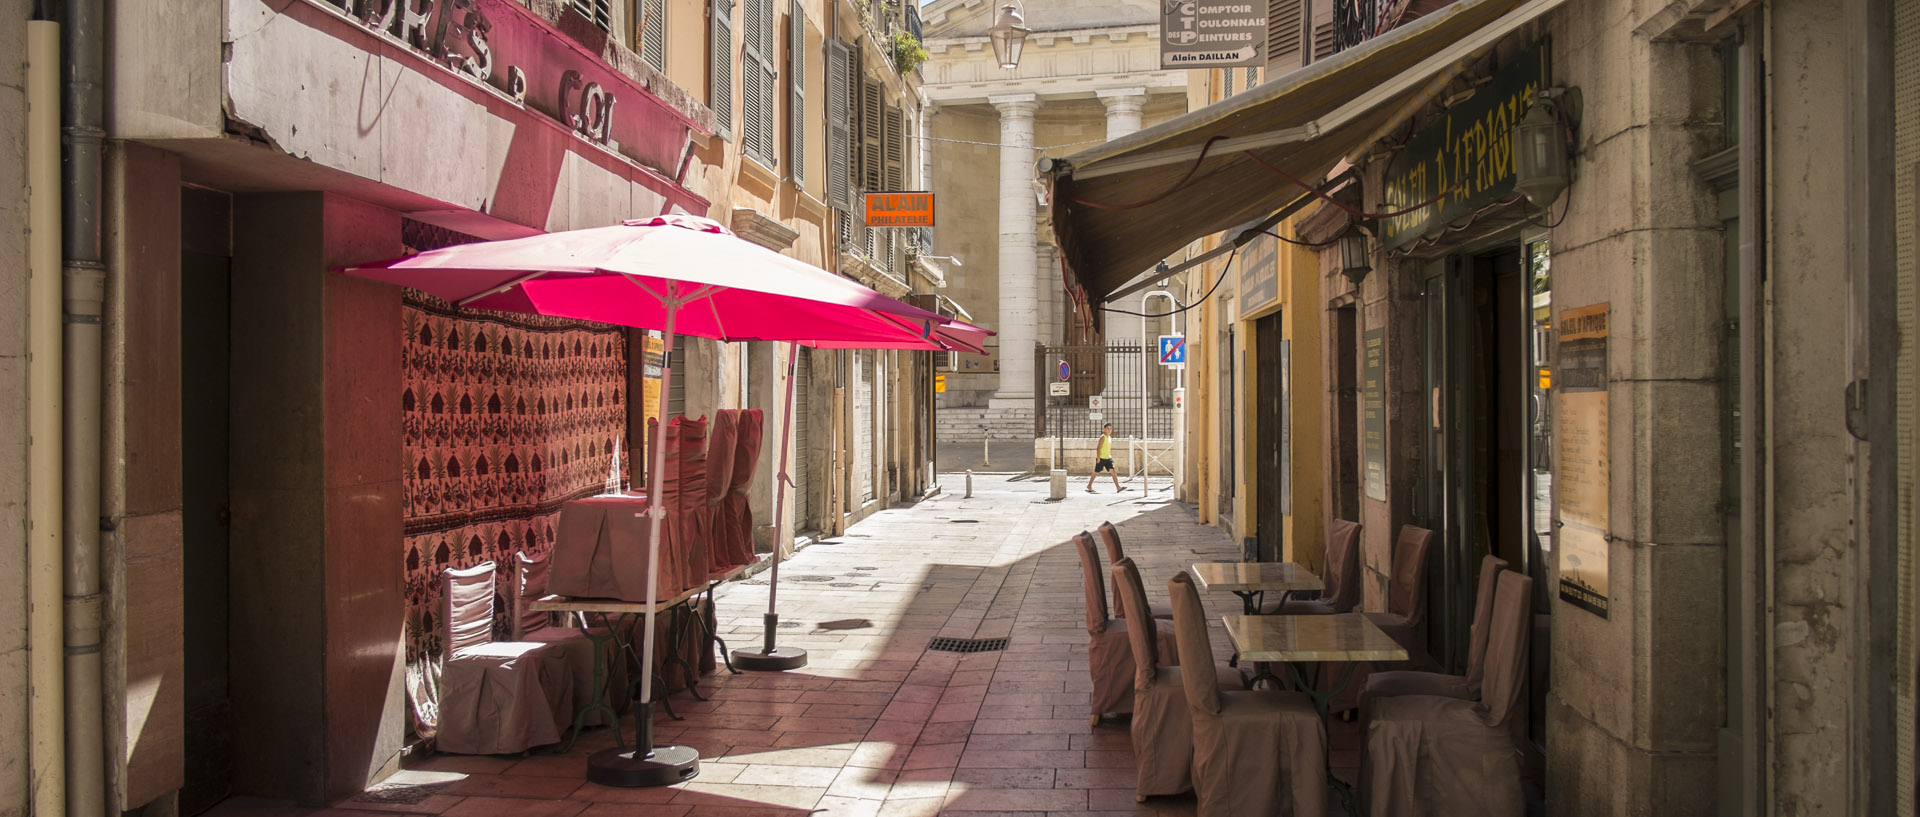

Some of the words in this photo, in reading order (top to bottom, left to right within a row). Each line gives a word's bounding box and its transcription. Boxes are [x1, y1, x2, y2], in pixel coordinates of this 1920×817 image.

[1168, 31, 1180, 39] DES
[872, 196, 928, 211] ALAIN
[1386, 159, 1431, 238] SOLEIL
[871, 216, 928, 224] PHILATELIE
